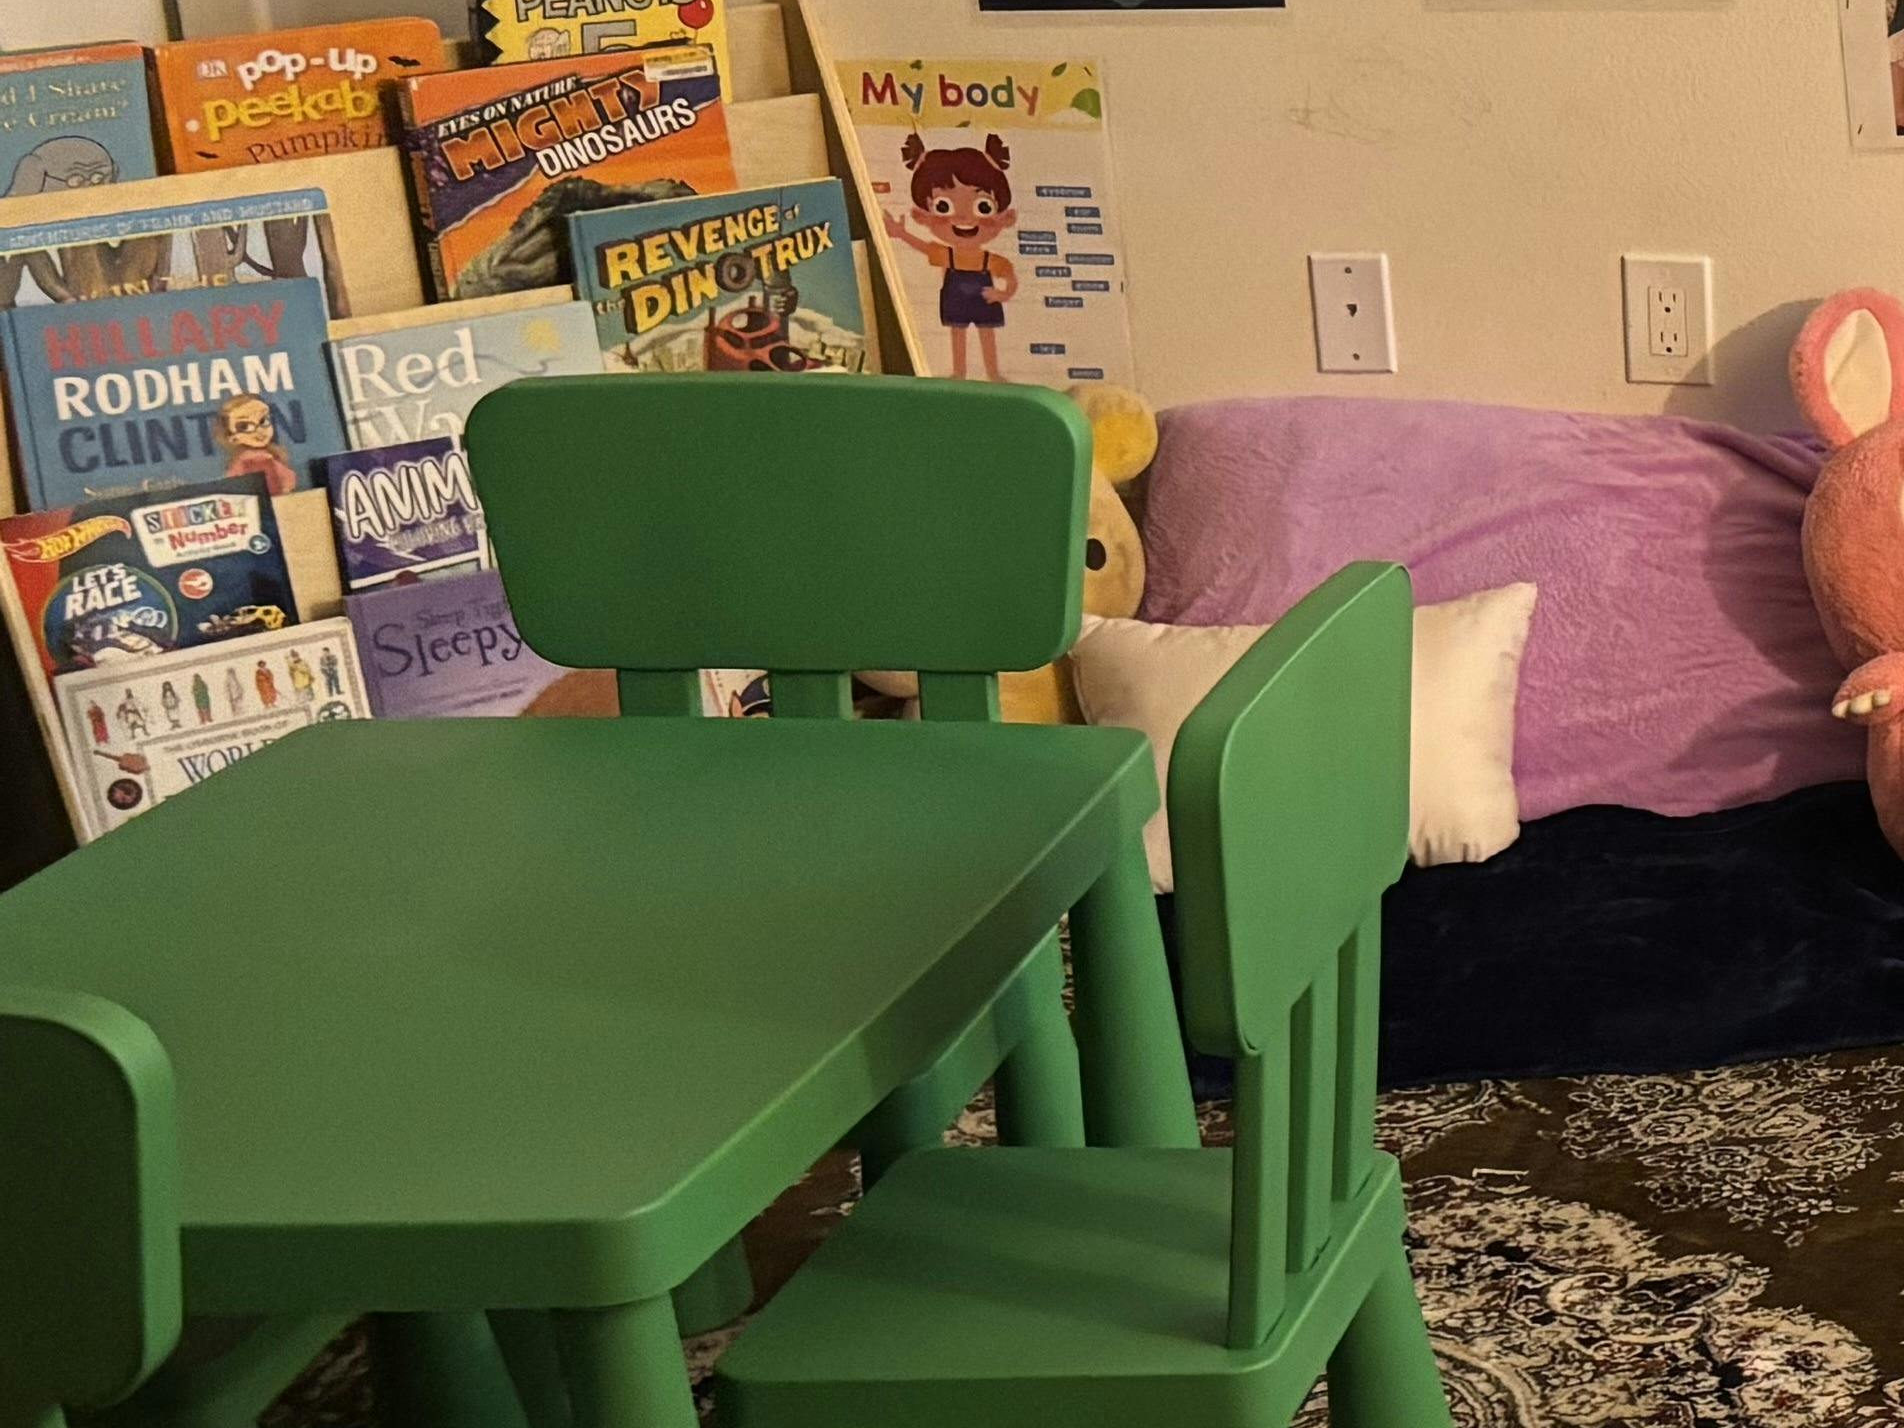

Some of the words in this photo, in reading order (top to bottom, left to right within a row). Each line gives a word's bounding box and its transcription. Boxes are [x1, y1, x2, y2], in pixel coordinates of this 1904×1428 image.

[237, 47, 377, 91] pop-up
[862, 72, 924, 113] My
[939, 74, 1039, 116] body
[438, 108, 481, 137] EYES
[483, 100, 511, 123] ON
[512, 76, 580, 117] NATURE
[440, 70, 663, 181] MIGHTY
[536, 98, 698, 179] DINOSAURS
[600, 205, 781, 290] REVENGE
[42, 300, 286, 372] HILLARY
[338, 328, 484, 403] Red
[53, 352, 295, 421] RODHAM
[168, 522, 249, 551] Number
[64, 575, 142, 620] RACE
[73, 563, 127, 592] LET'S
[373, 620, 524, 678] Sleepy
